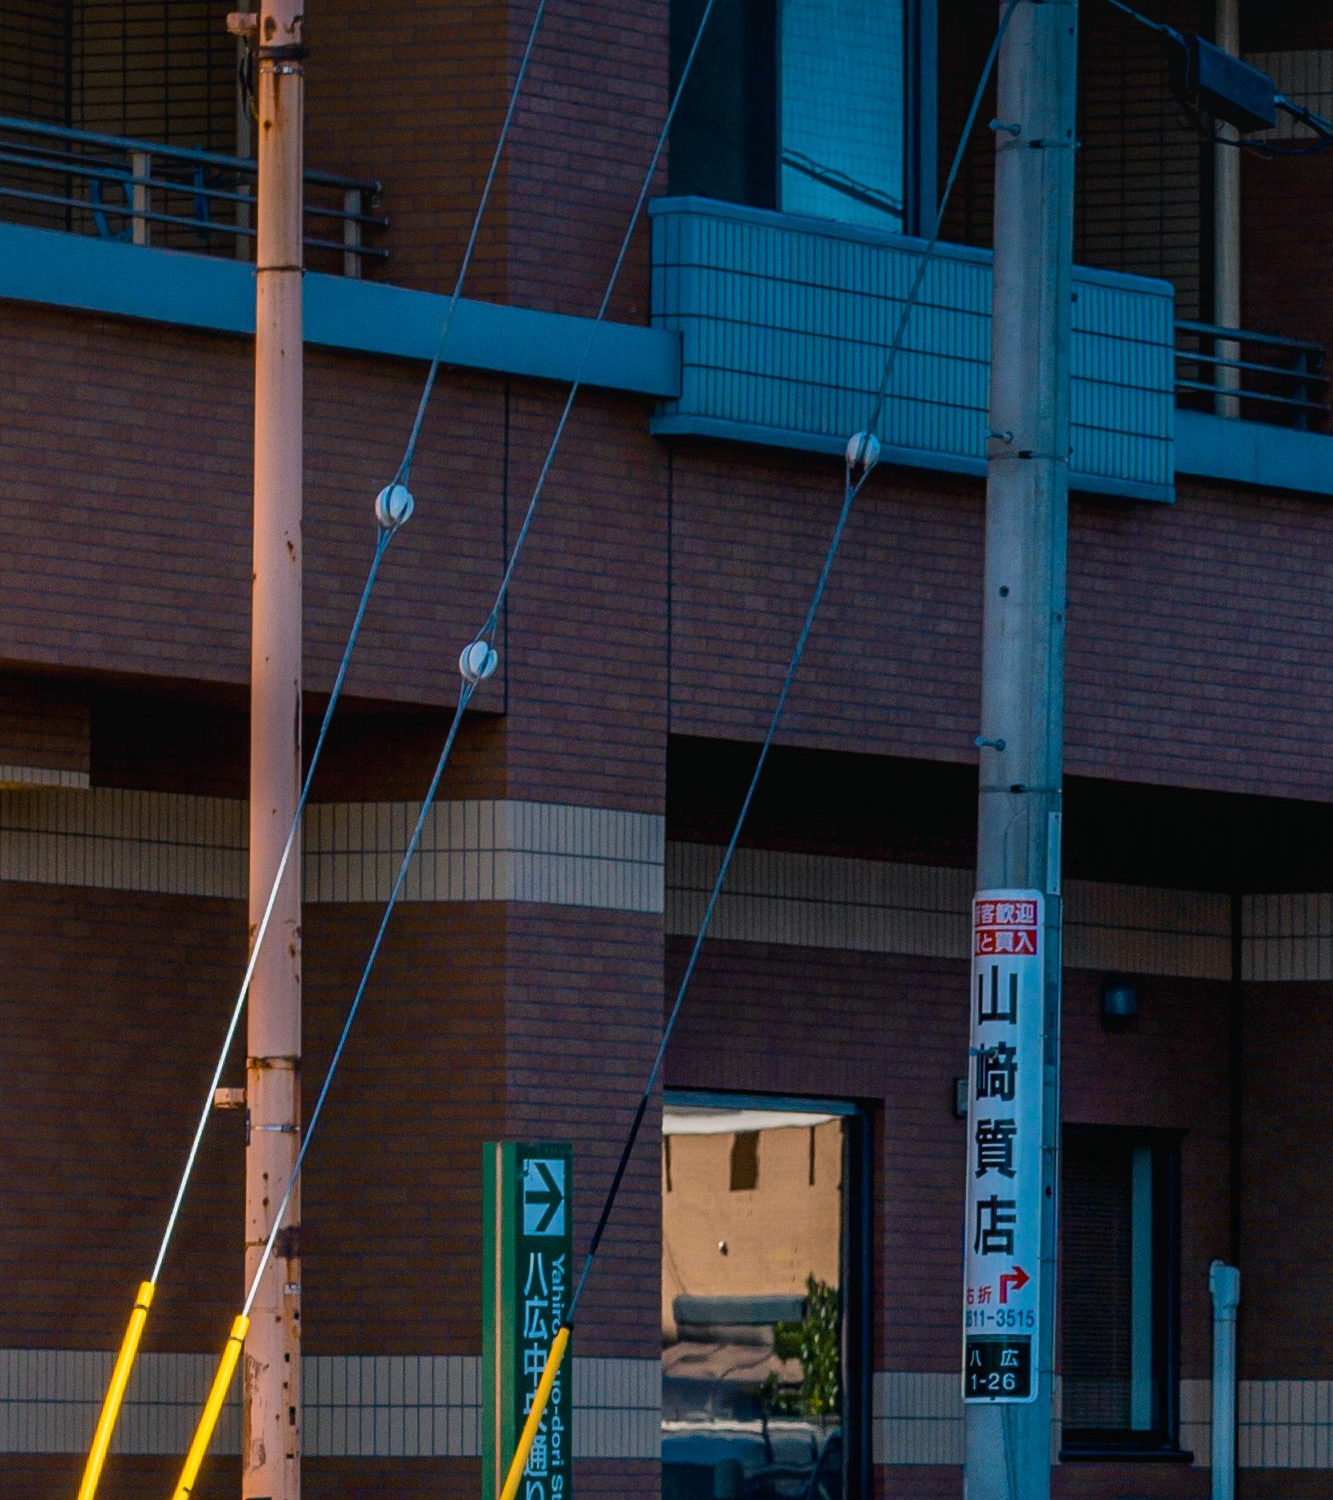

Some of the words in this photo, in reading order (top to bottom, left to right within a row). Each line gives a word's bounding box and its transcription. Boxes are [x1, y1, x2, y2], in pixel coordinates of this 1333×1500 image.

[976, 903, 1034, 924] 客歓迎
[969, 1348, 1019, 1367] 八広
[971, 1372, 1016, 1390] 1-26
